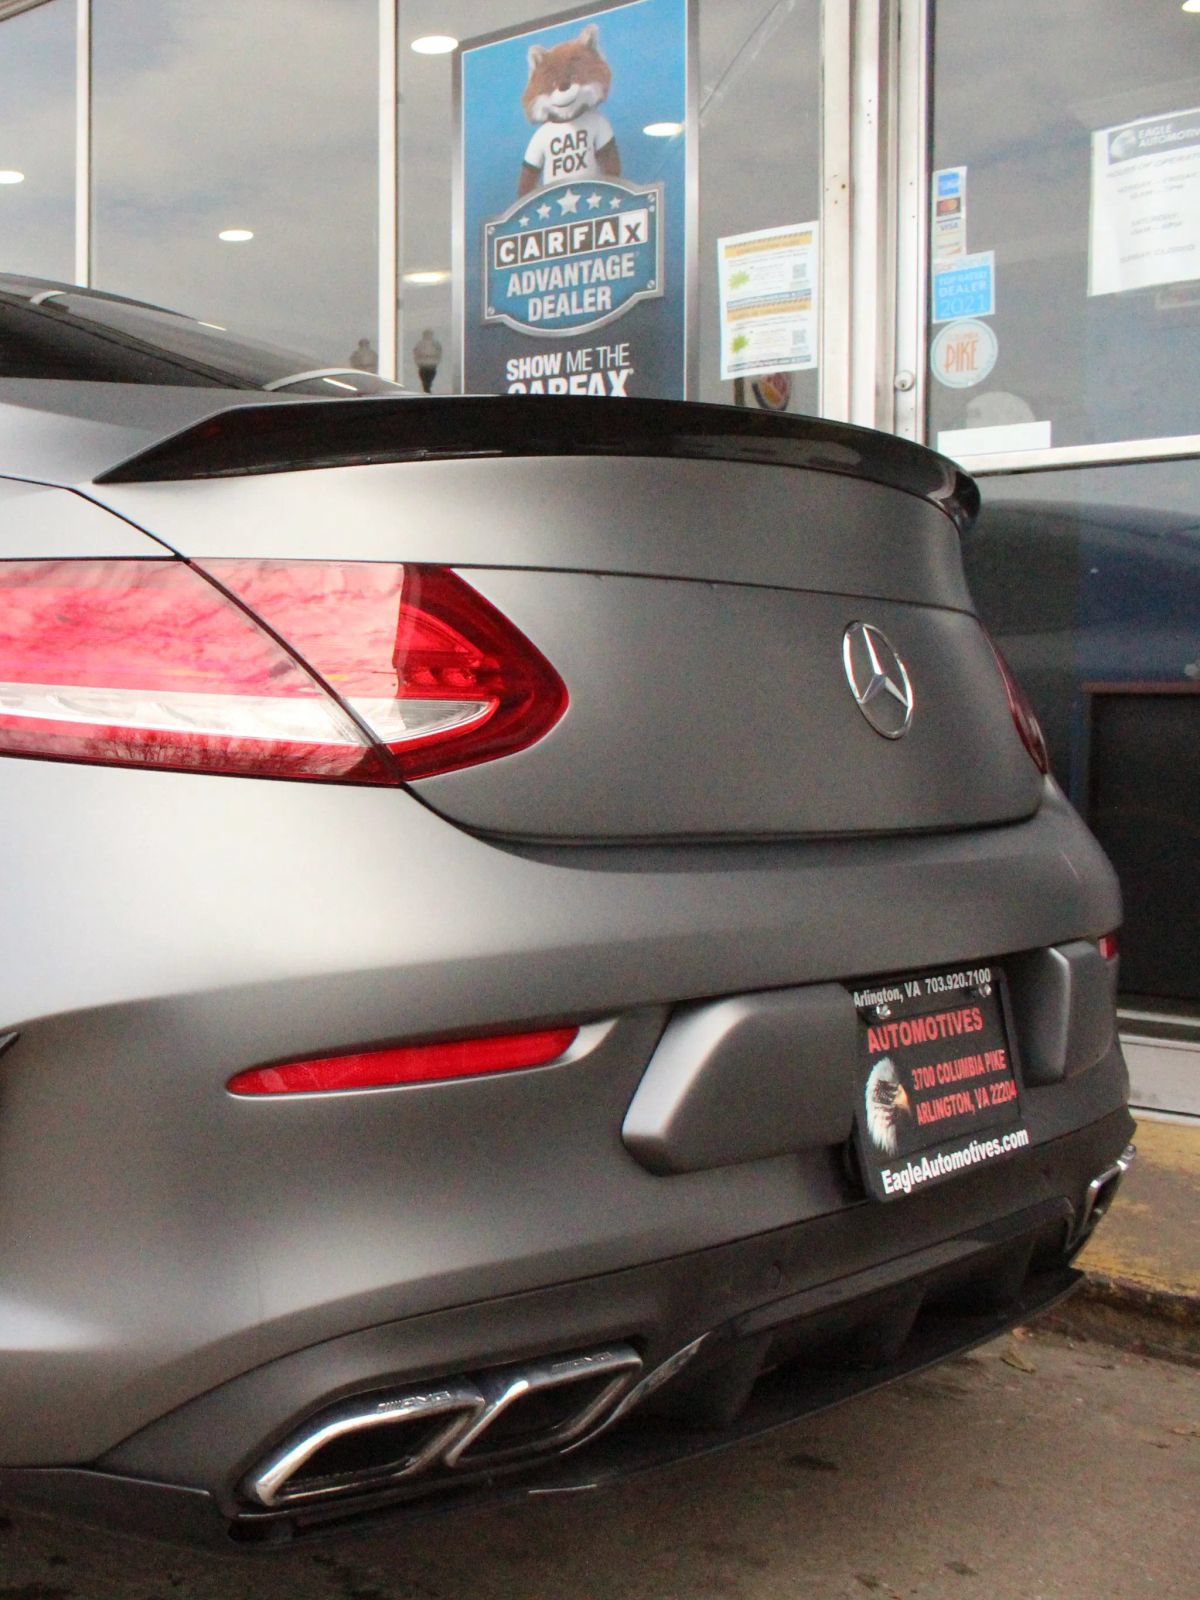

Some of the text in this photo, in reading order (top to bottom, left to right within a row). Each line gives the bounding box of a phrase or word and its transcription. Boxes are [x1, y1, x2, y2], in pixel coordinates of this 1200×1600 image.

[550, 129, 588, 156] CAR
[1138, 123, 1173, 139] EAGLE
[552, 151, 588, 176] FOX
[498, 215, 645, 265] CARFAX
[506, 251, 636, 298] ADVANTAGE
[939, 279, 987, 298] DEALER
[528, 285, 612, 322] DEALER
[940, 294, 987, 318] 2021
[506, 343, 631, 381] SHOW ME THE
[944, 338, 980, 374] PIKE
[853, 967, 992, 1007] Arlington, VA 703.920.7100
[867, 1007, 983, 1053] AUTOMOTIVES
[912, 1048, 1007, 1091] 3700 COLUMBIA PIKE
[916, 1079, 1017, 1126] ARLINGTON, VA 22204
[880, 1128, 1030, 1195] EagleAutomotives.com
